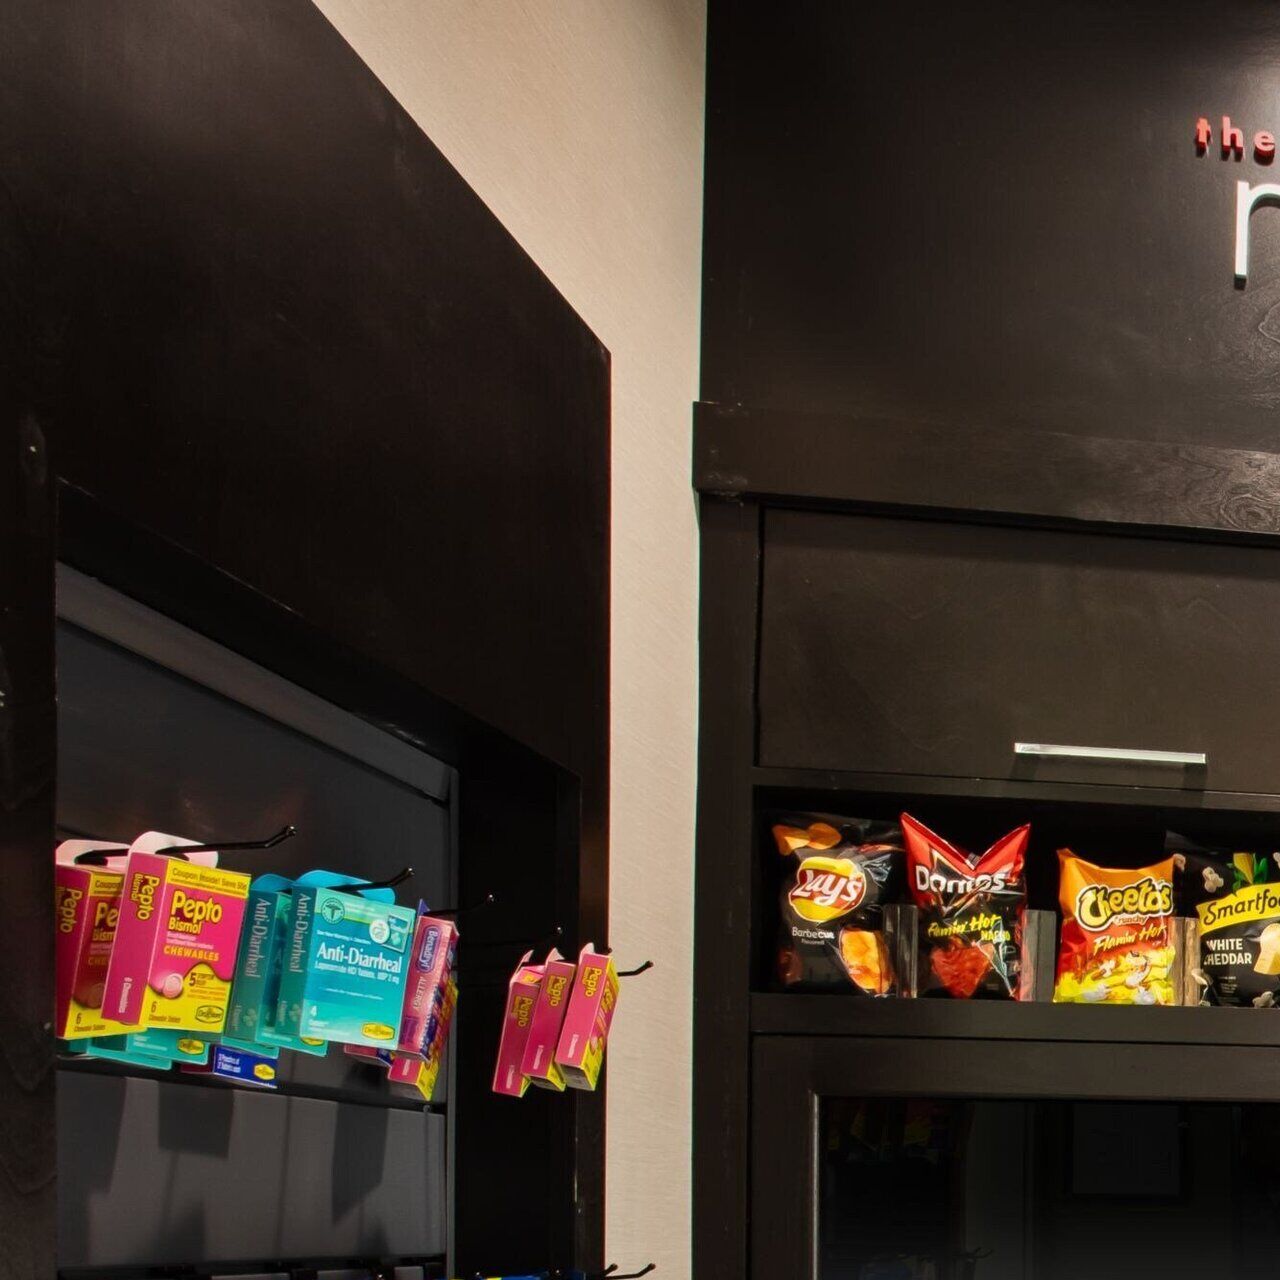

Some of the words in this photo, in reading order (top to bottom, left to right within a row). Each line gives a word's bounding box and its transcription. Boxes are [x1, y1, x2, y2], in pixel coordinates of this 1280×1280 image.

[1196, 116, 1276, 163] the
[138, 875, 160, 921] Pepto
[794, 870, 864, 906] Lay's
[1076, 877, 1174, 931] Cheetos
[60, 887, 84, 934] Pepto
[171, 889, 223, 924] Pepto
[169, 917, 202, 935] Bismol
[244, 897, 272, 979] Anti-Diarrheal
[288, 893, 312, 974] Anti-Diarrheal
[163, 945, 220, 962] CHEWABLES
[316, 942, 403, 974] Anti-Diarrheal
[1206, 938, 1243, 951] WHITE
[550, 976, 567, 1007] Pepto
[585, 967, 603, 997] Pepto
[151, 1001, 157, 1014] 6
[518, 997, 533, 1027] Pepto
